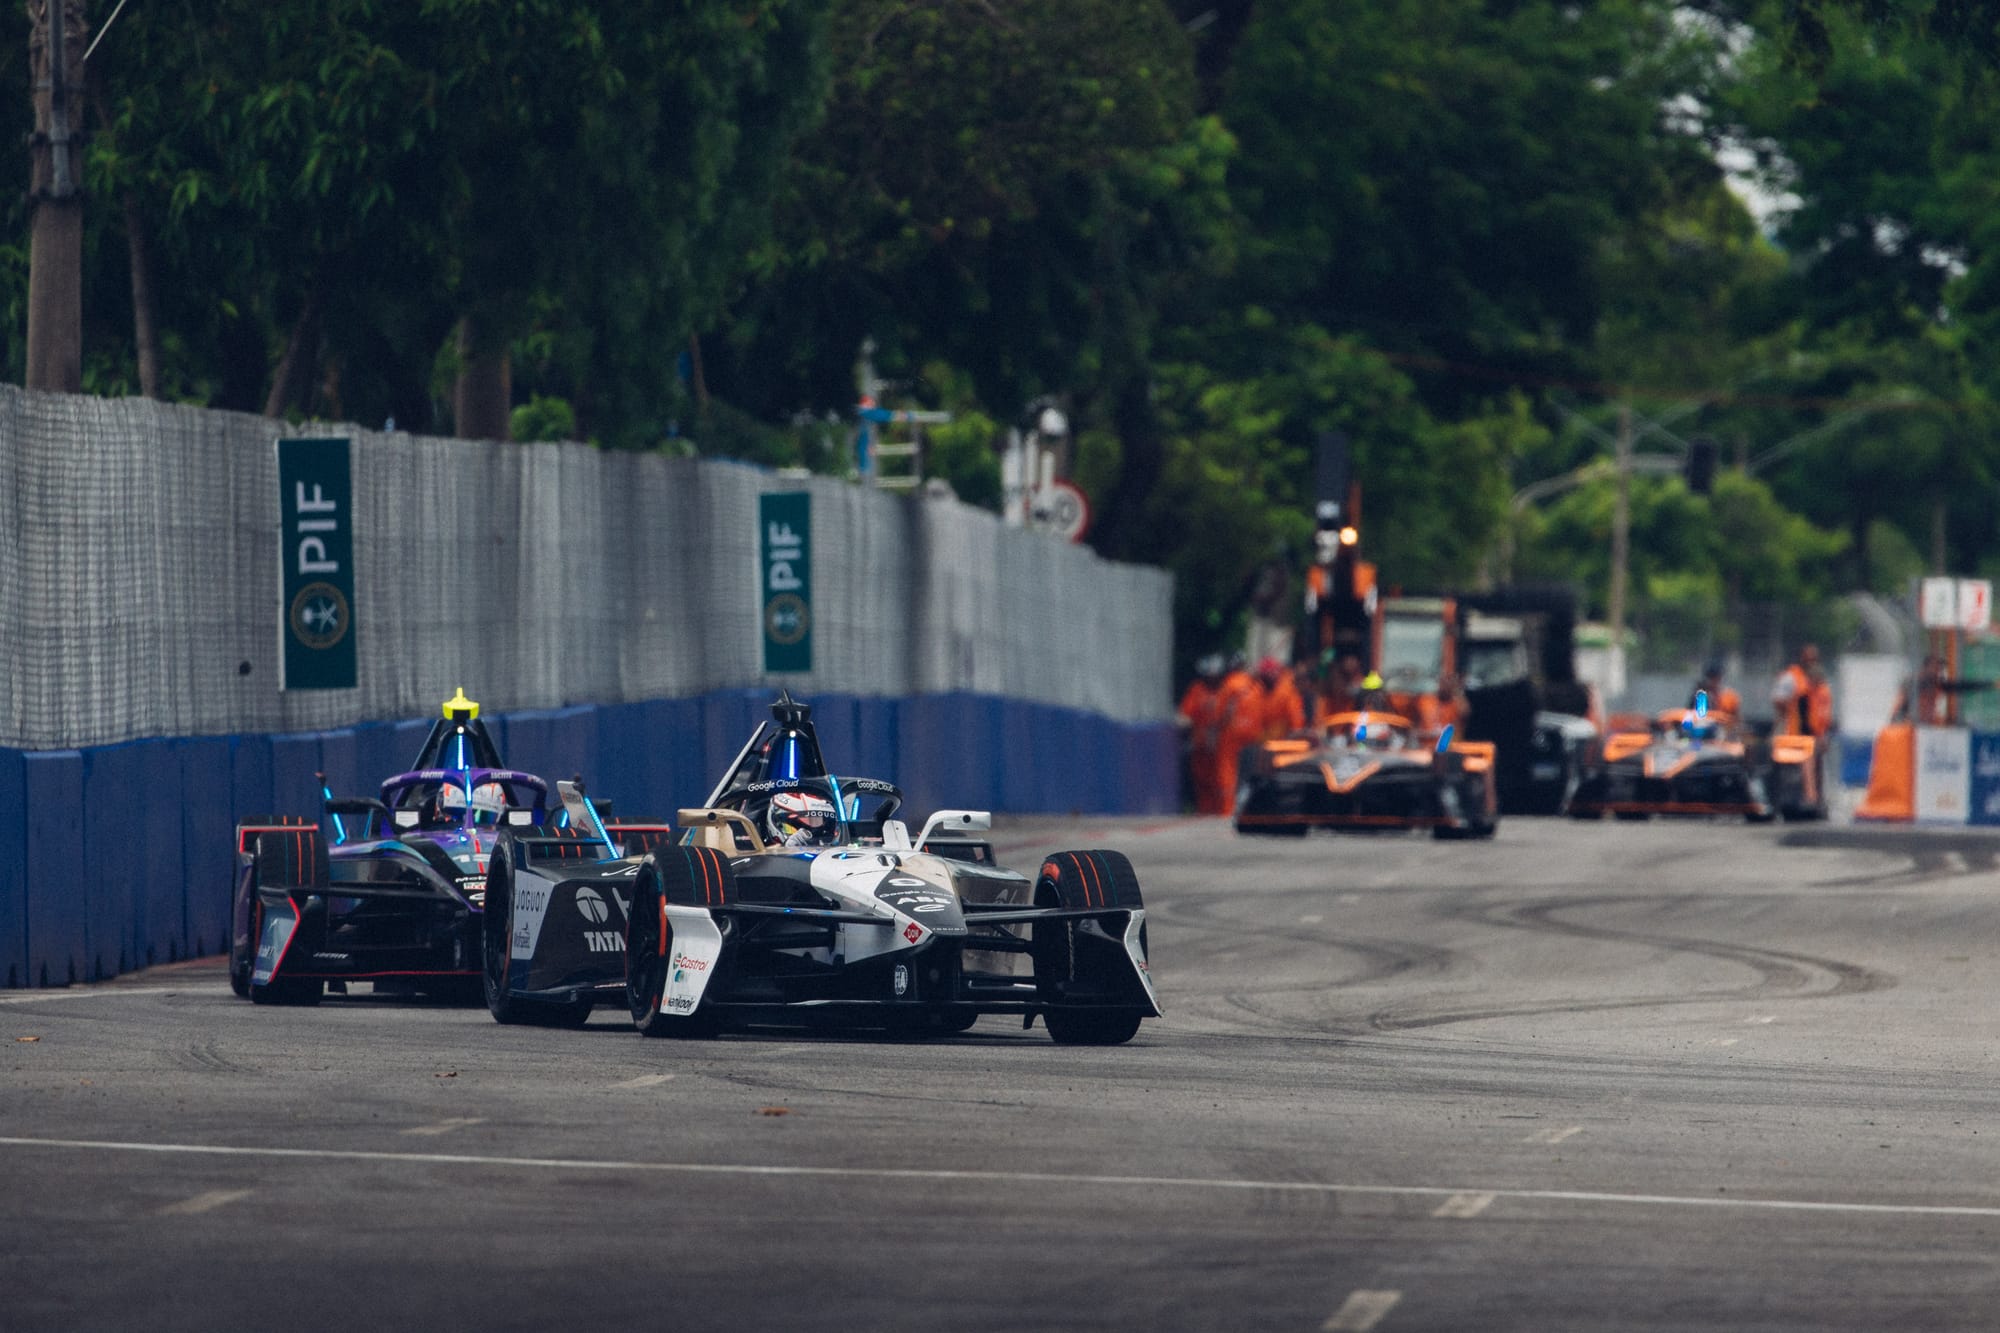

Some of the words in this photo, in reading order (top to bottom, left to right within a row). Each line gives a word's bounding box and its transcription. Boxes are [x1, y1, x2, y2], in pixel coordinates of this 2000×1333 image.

[296, 480, 338, 573] PIF
[769, 521, 802, 590] PIF
[748, 780, 775, 792] Google
[776, 778, 799, 788] Cloud
[857, 779, 878, 791] Google
[878, 782, 894, 793] Cloud
[583, 931, 626, 952] TATA
[681, 956, 709, 972] Castrol
